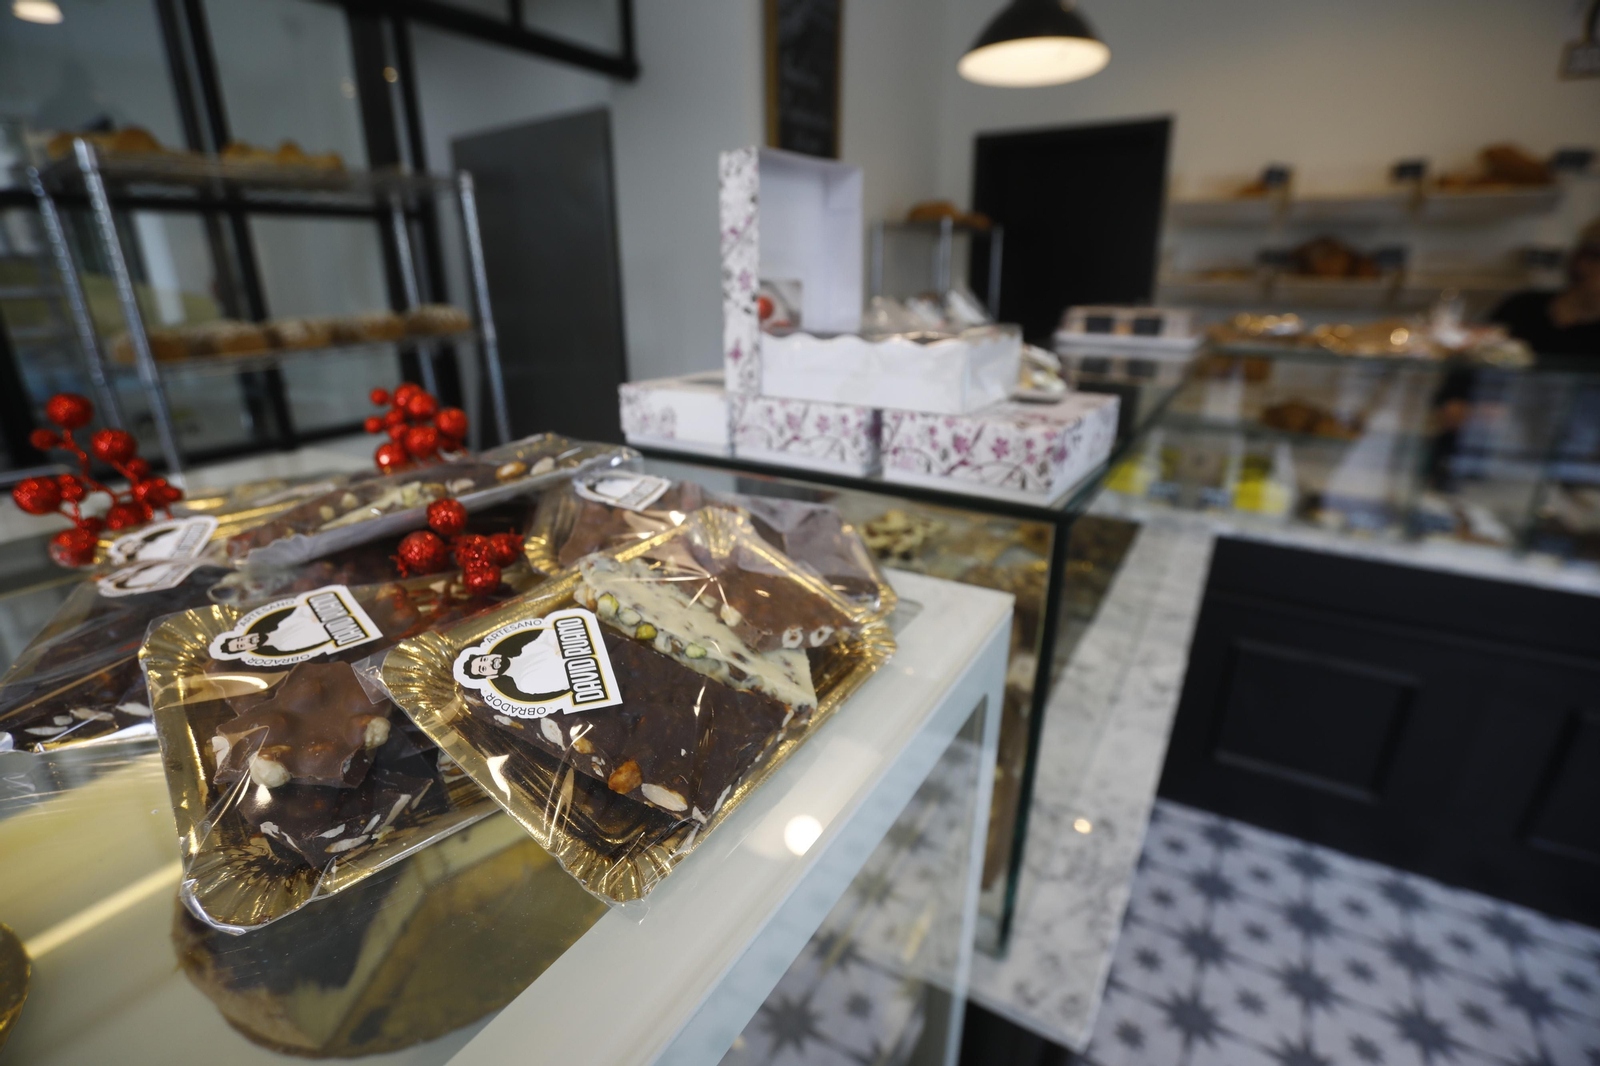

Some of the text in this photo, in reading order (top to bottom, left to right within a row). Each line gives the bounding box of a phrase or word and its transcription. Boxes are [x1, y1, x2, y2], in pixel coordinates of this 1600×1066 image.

[486, 618, 543, 644] ARTESANO
[556, 616, 605, 704] DAVID RUANO
[485, 692, 547, 716] OBRADOR
